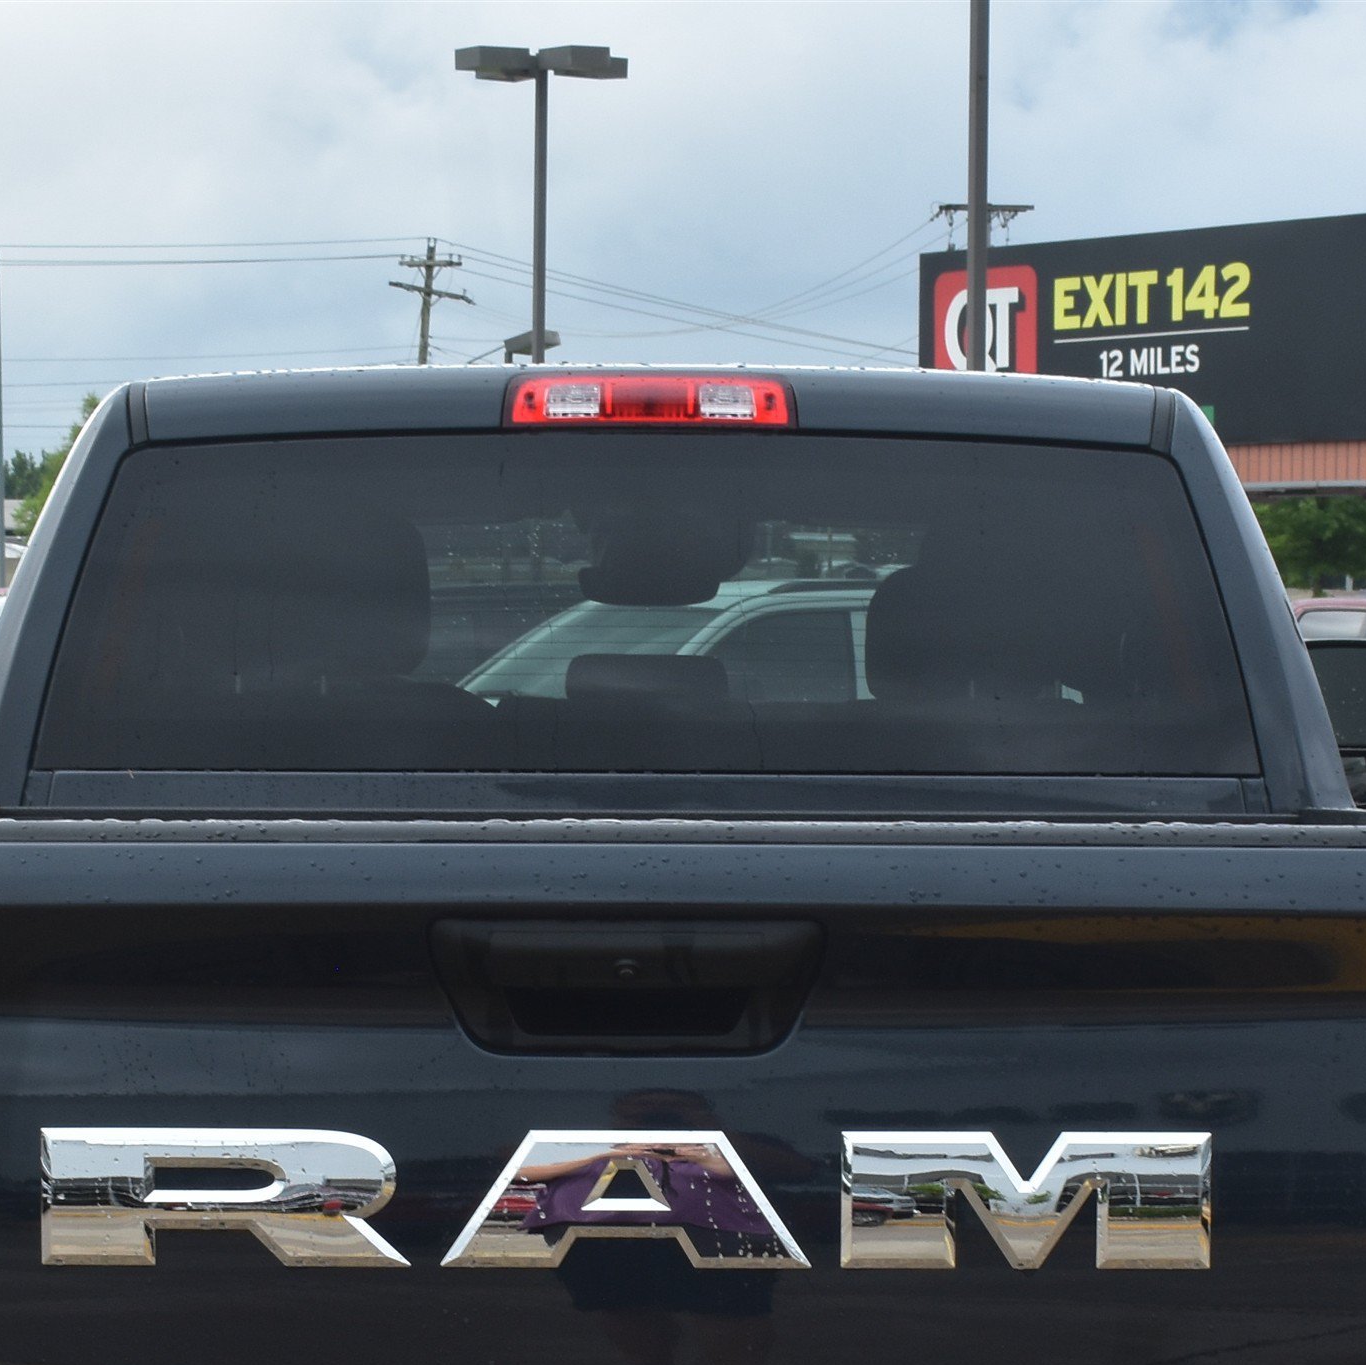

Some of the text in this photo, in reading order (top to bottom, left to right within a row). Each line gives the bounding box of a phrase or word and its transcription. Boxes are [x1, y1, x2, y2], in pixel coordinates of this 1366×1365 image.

[945, 287, 1019, 371] QT
[1054, 262, 1251, 330] EXIT 142
[1099, 344, 1200, 378] 12 MILES
[40, 1127, 1213, 1271] RAM
